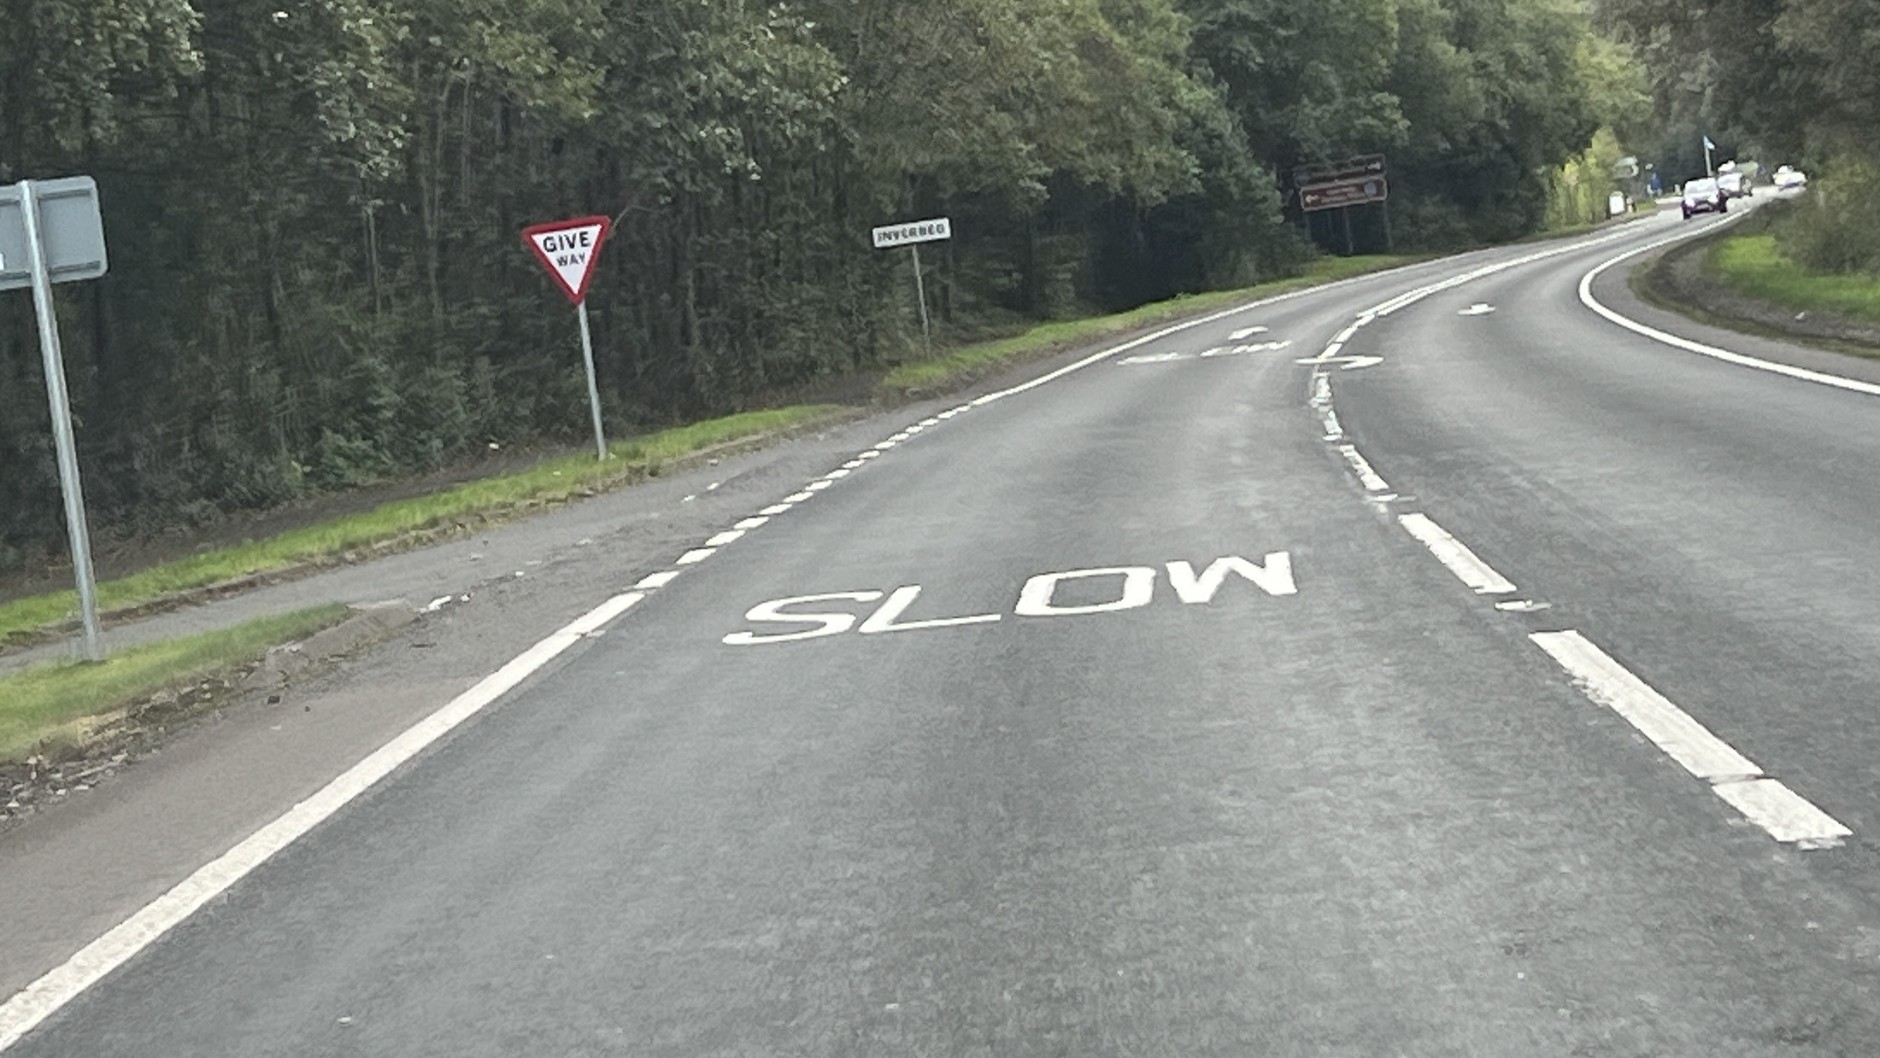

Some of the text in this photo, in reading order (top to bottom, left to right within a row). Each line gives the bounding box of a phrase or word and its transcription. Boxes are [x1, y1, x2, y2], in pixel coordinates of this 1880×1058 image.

[543, 231, 591, 252] GIVE
[557, 252, 586, 267] WAY
[722, 550, 1298, 645] SLOW
